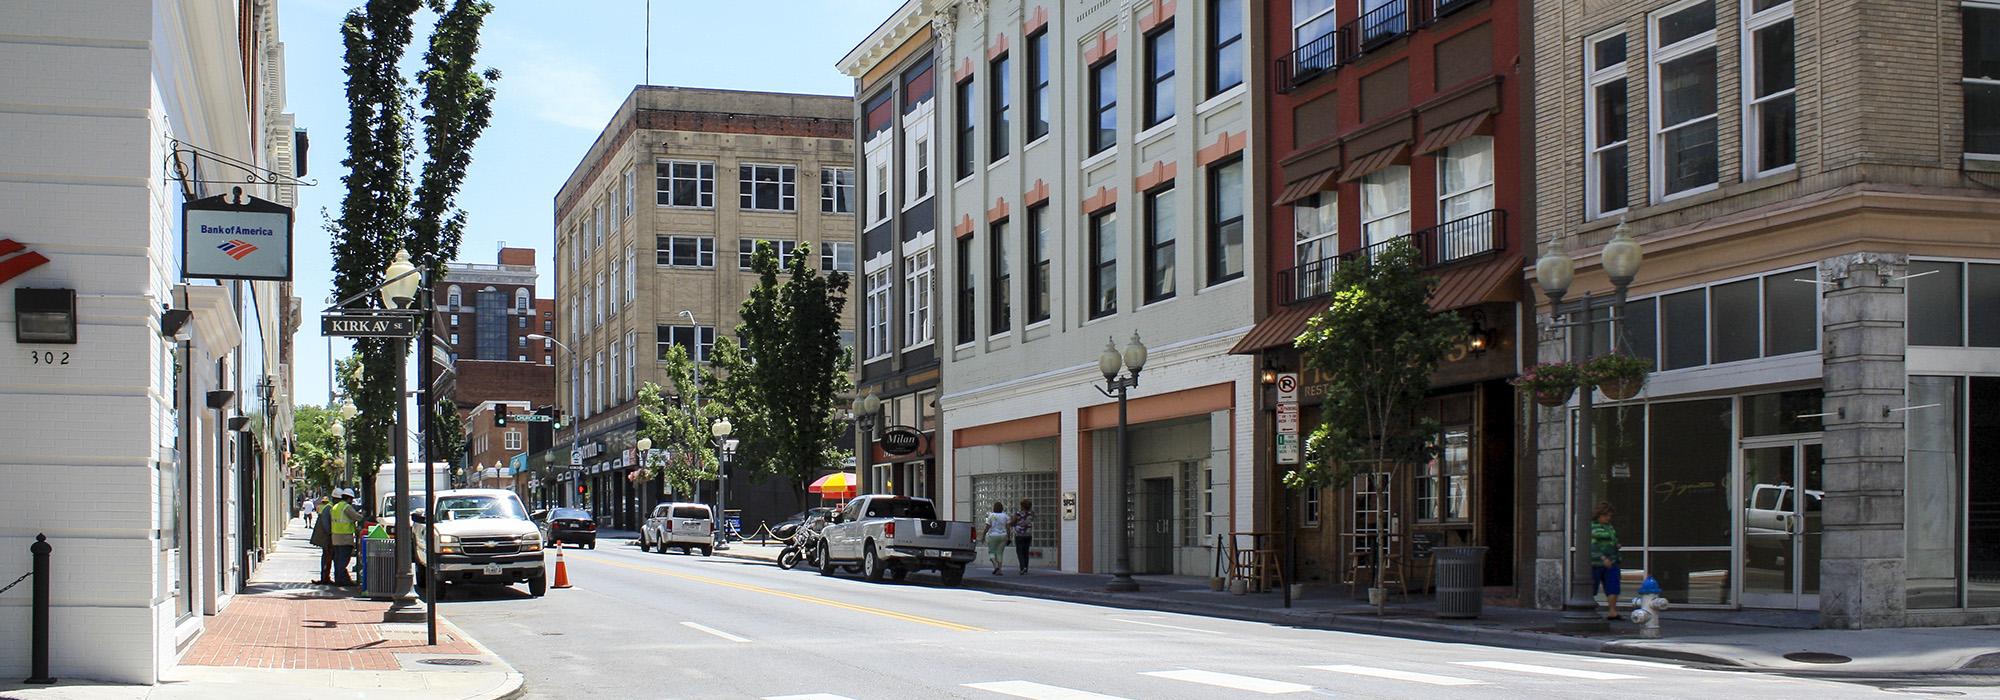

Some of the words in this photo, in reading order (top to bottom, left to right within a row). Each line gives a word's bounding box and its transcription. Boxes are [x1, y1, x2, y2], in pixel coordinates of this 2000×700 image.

[201, 225, 224, 234] Bank
[225, 226, 235, 235] of
[235, 226, 273, 236] America
[332, 320, 370, 332] KIRK
[372, 320, 390, 332] AV
[393, 322, 403, 330] SE
[31, 350, 70, 365] 302
[888, 433, 915, 443] Milan
